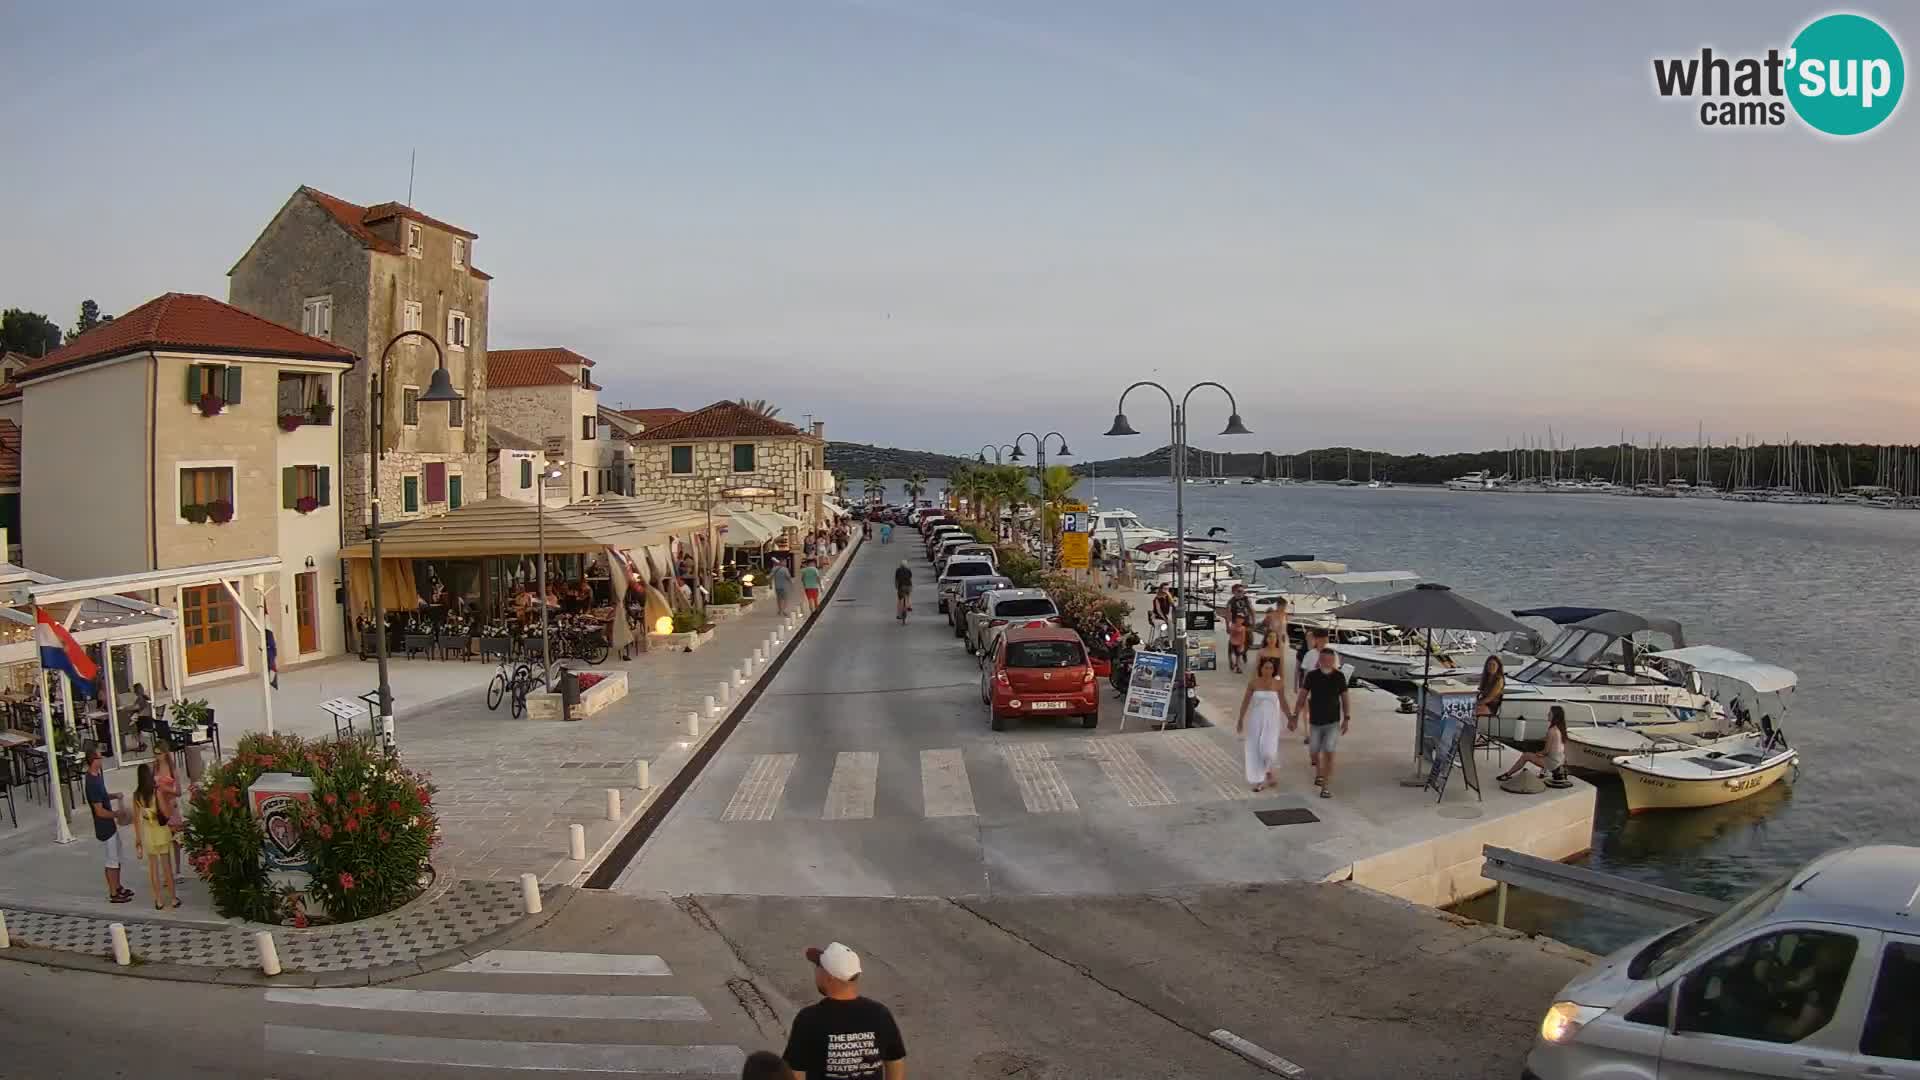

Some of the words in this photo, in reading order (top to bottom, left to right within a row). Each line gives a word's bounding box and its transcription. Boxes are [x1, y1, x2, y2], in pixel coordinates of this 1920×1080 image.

[1065, 514, 1075, 531] P
[1630, 694, 1648, 703] RENT
[1648, 694, 1653, 704] A
[1654, 694, 1670, 704] BOAT
[1443, 703, 1473, 711] RENT
[1441, 711, 1449, 720] A
[828, 1034, 847, 1042] THE
[847, 1032, 875, 1041] BRONX
[828, 1041, 874, 1050] BROOKLYN
[828, 1048, 879, 1057] MANHATTAN
[827, 1057, 863, 1065] QUEENS
[827, 1064, 858, 1072] STATEN
